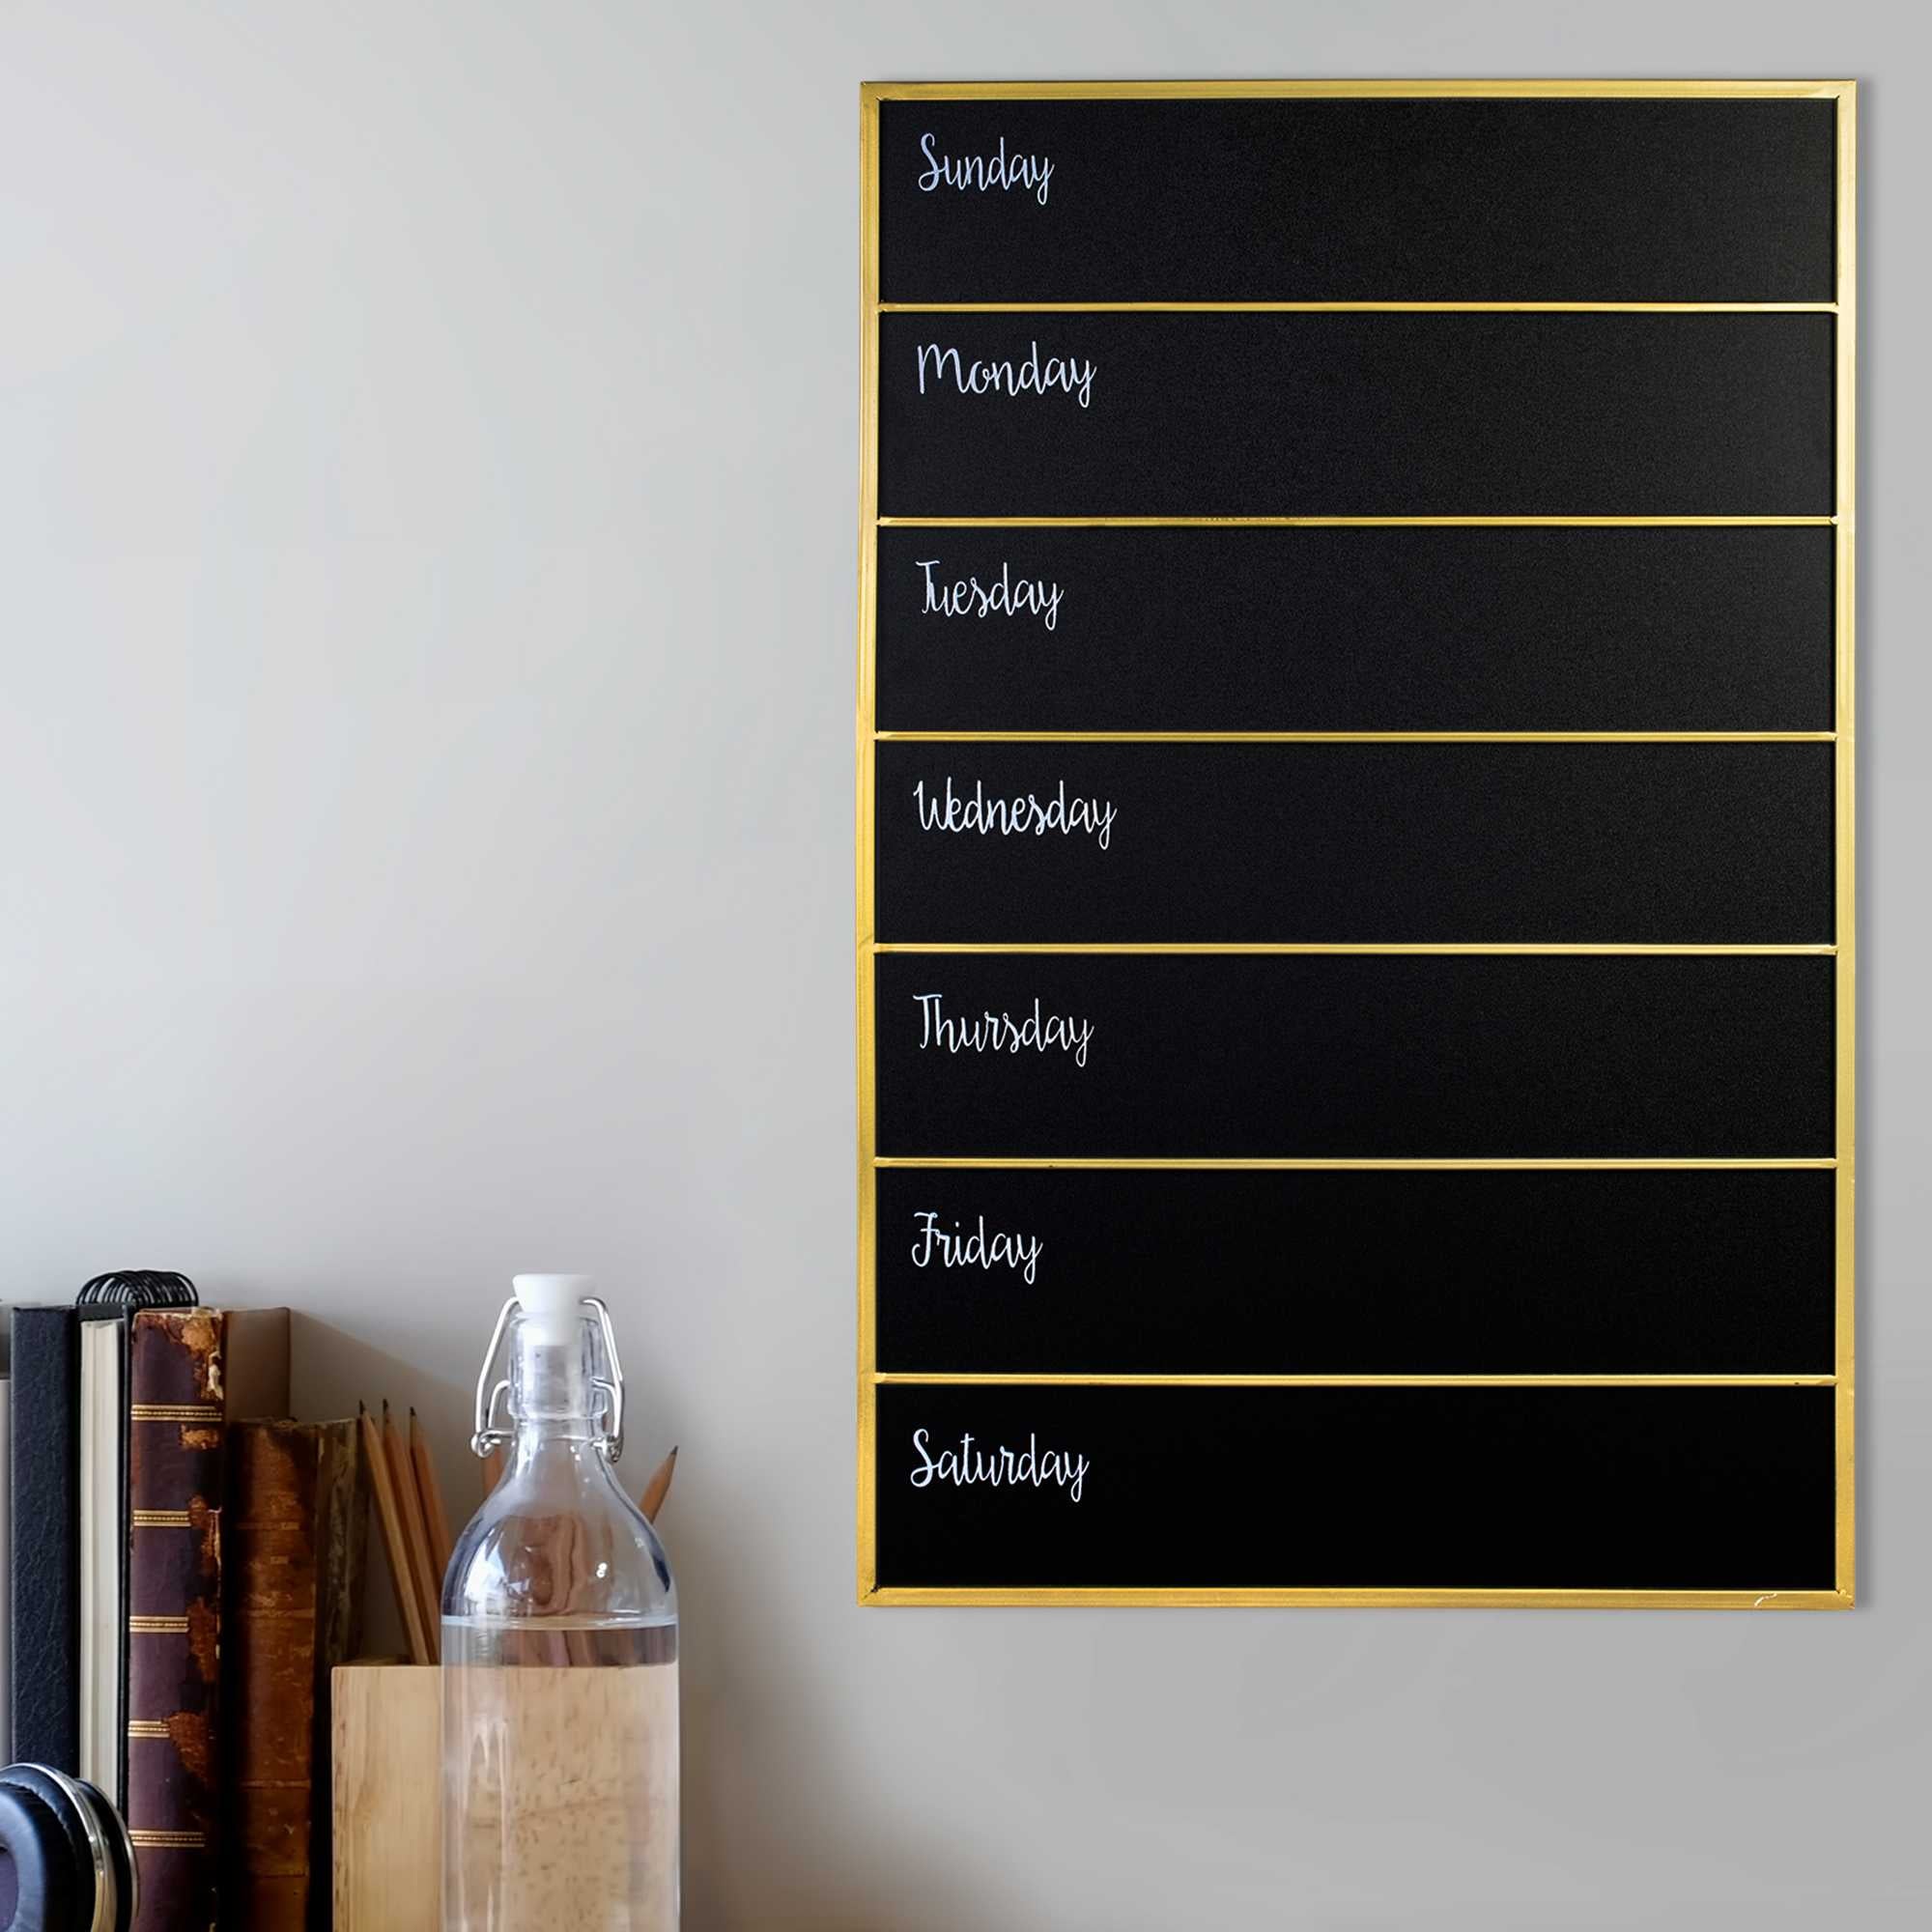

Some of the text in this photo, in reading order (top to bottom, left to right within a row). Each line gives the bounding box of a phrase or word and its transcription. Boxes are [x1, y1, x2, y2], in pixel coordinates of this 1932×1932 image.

[918, 132, 1055, 206] Sunday
[917, 340, 1097, 409] Monday
[915, 559, 1065, 632] Tuesday
[912, 776, 1118, 851] Wednesday
[912, 993, 1095, 1068] Thursday
[911, 1211, 1044, 1286] Friday
[910, 1428, 1091, 1503] Saturday
